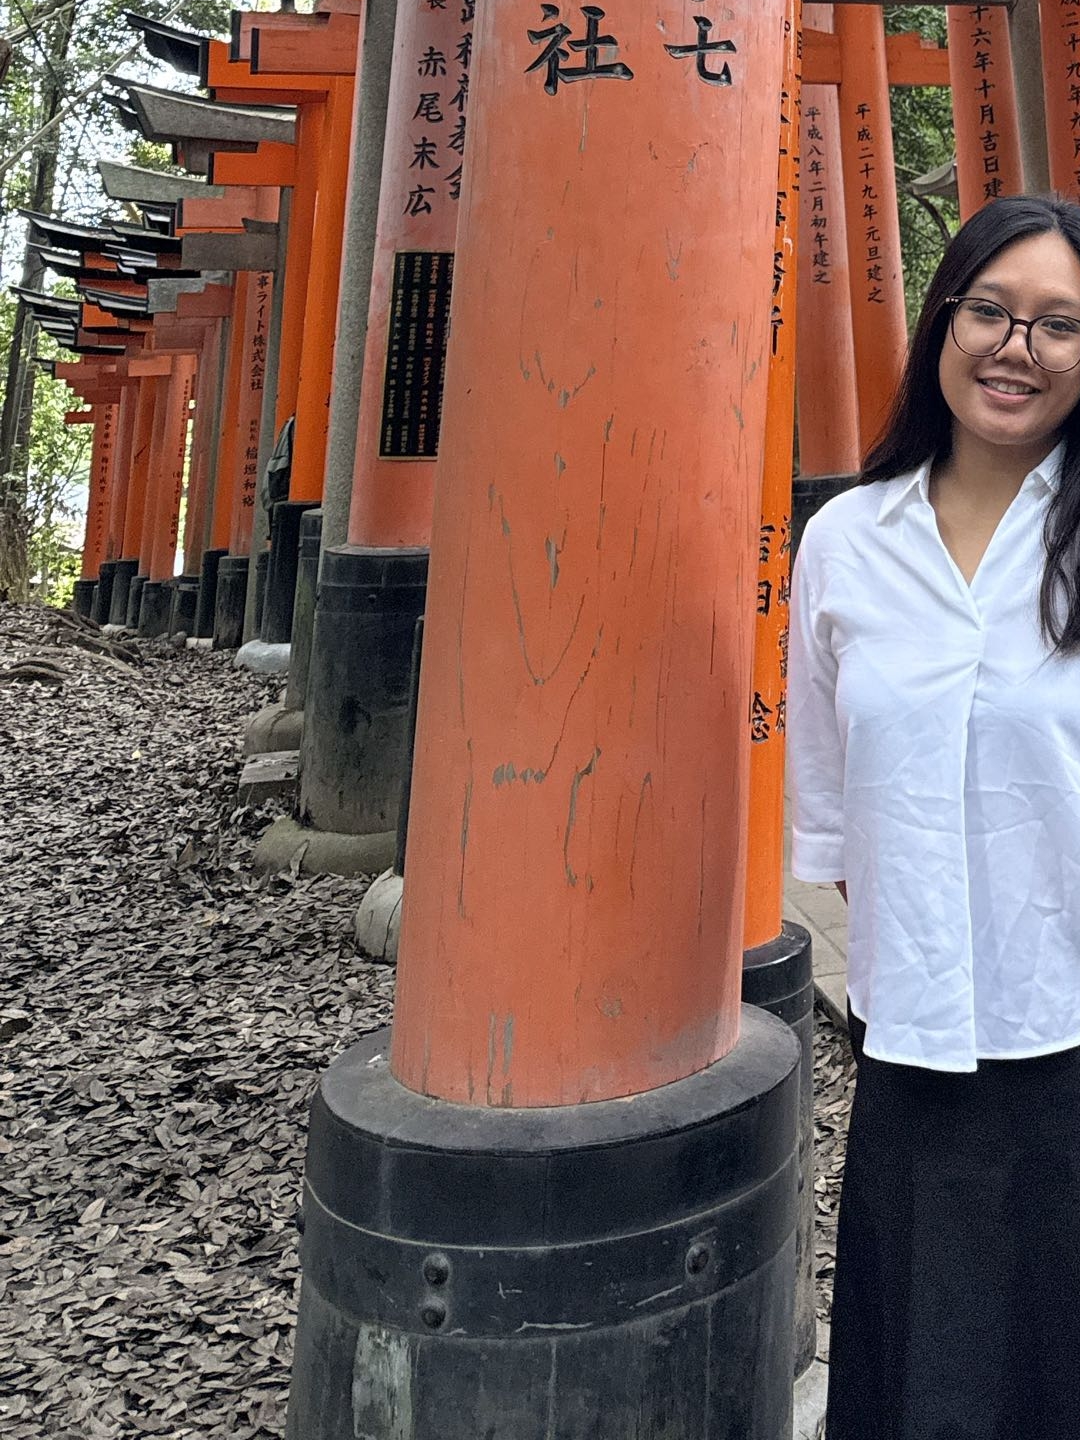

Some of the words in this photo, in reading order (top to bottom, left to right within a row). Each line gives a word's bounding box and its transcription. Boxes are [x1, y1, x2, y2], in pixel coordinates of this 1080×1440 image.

[402, 46, 449, 217] 赤尾末広
[805, 106, 831, 284] 平成八年二月初午建之
[855, 103, 886, 304] 平成二十九年元旦建之
[251, 270, 270, 391] 事ライト株式会社
